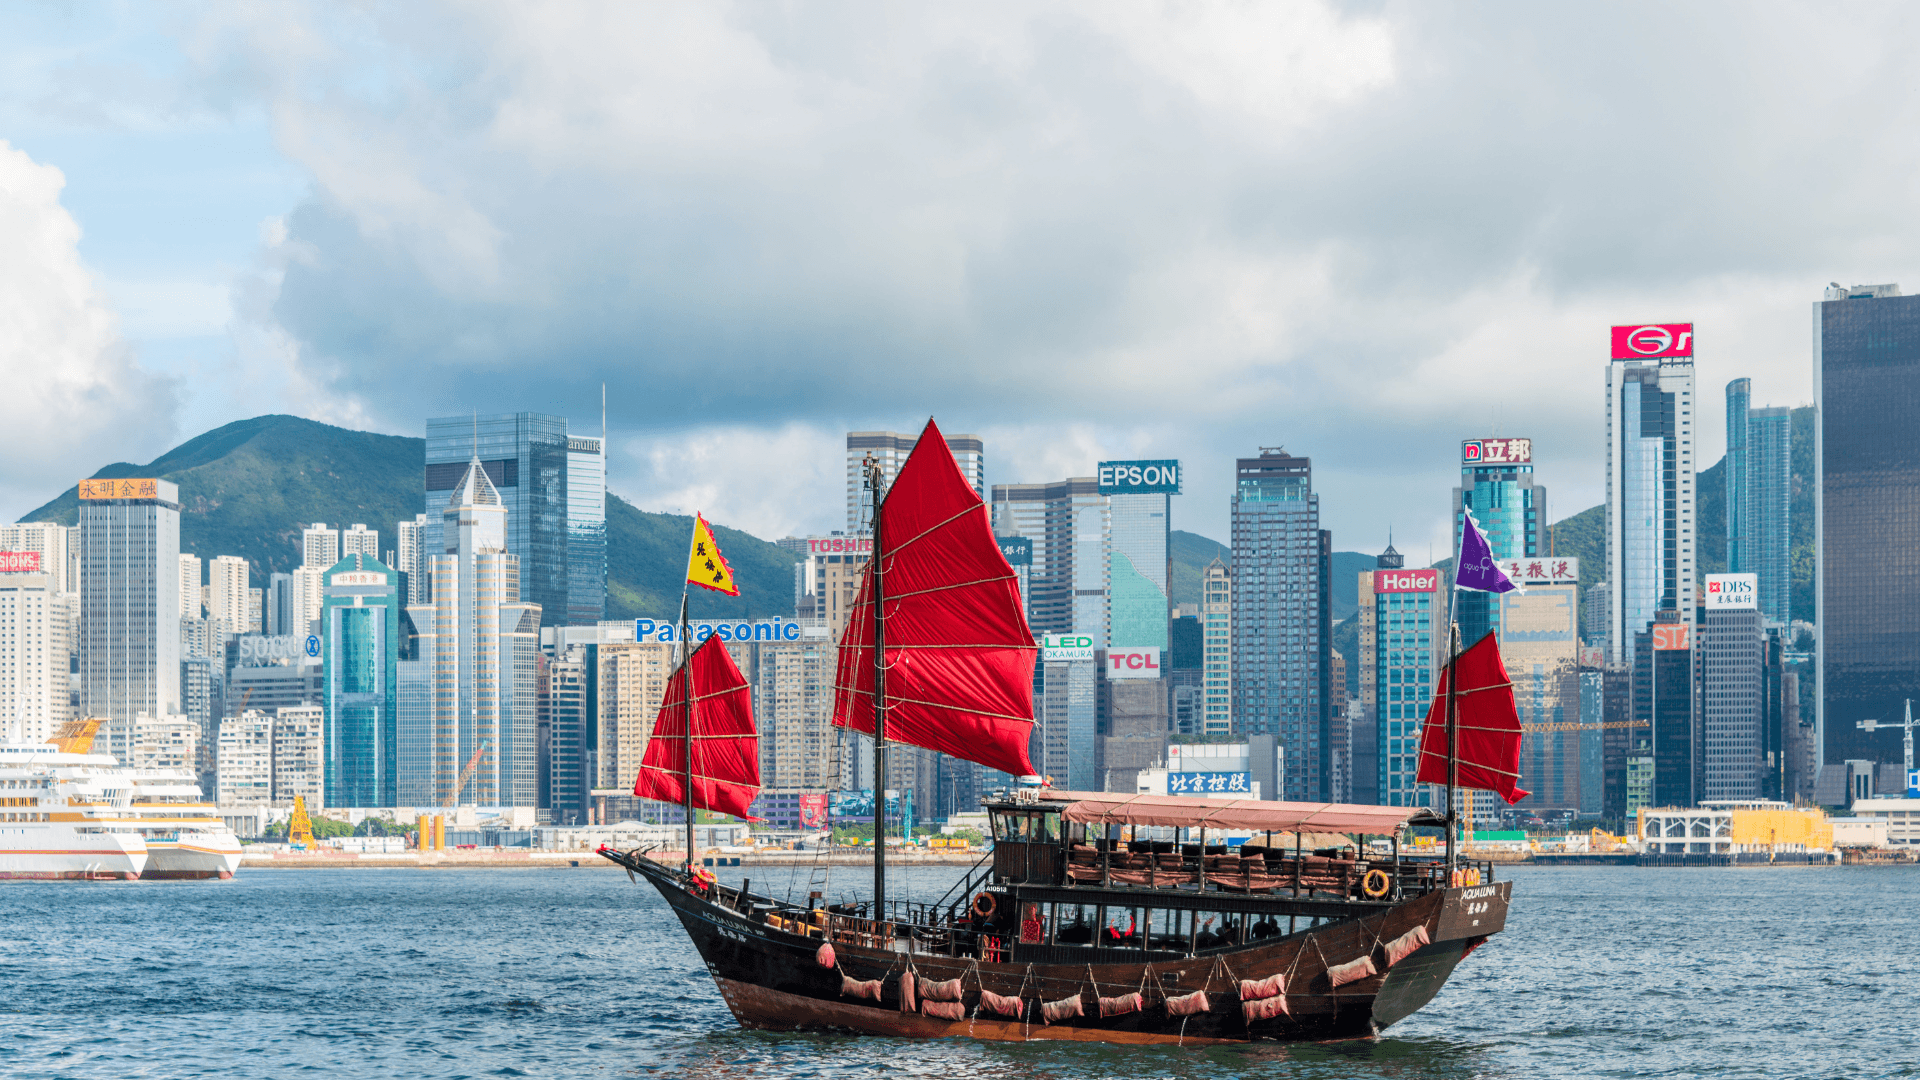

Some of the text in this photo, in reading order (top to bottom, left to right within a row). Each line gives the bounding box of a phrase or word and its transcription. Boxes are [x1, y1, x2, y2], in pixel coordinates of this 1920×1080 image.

[1484, 439, 1530, 462] 立邦
[1100, 466, 1176, 485] EPSON
[81, 480, 156, 498] 永明金融
[998, 546, 1026, 555] 銀行
[1383, 573, 1435, 589] Haier
[1723, 581, 1752, 593] DBS
[635, 616, 800, 643] Panasonic
[240, 635, 301, 657] SOGO
[1045, 637, 1092, 648] LED
[1045, 650, 1093, 659] OKAMURA
[1109, 653, 1158, 669] TCL
[1171, 773, 1249, 792] 北京控股
